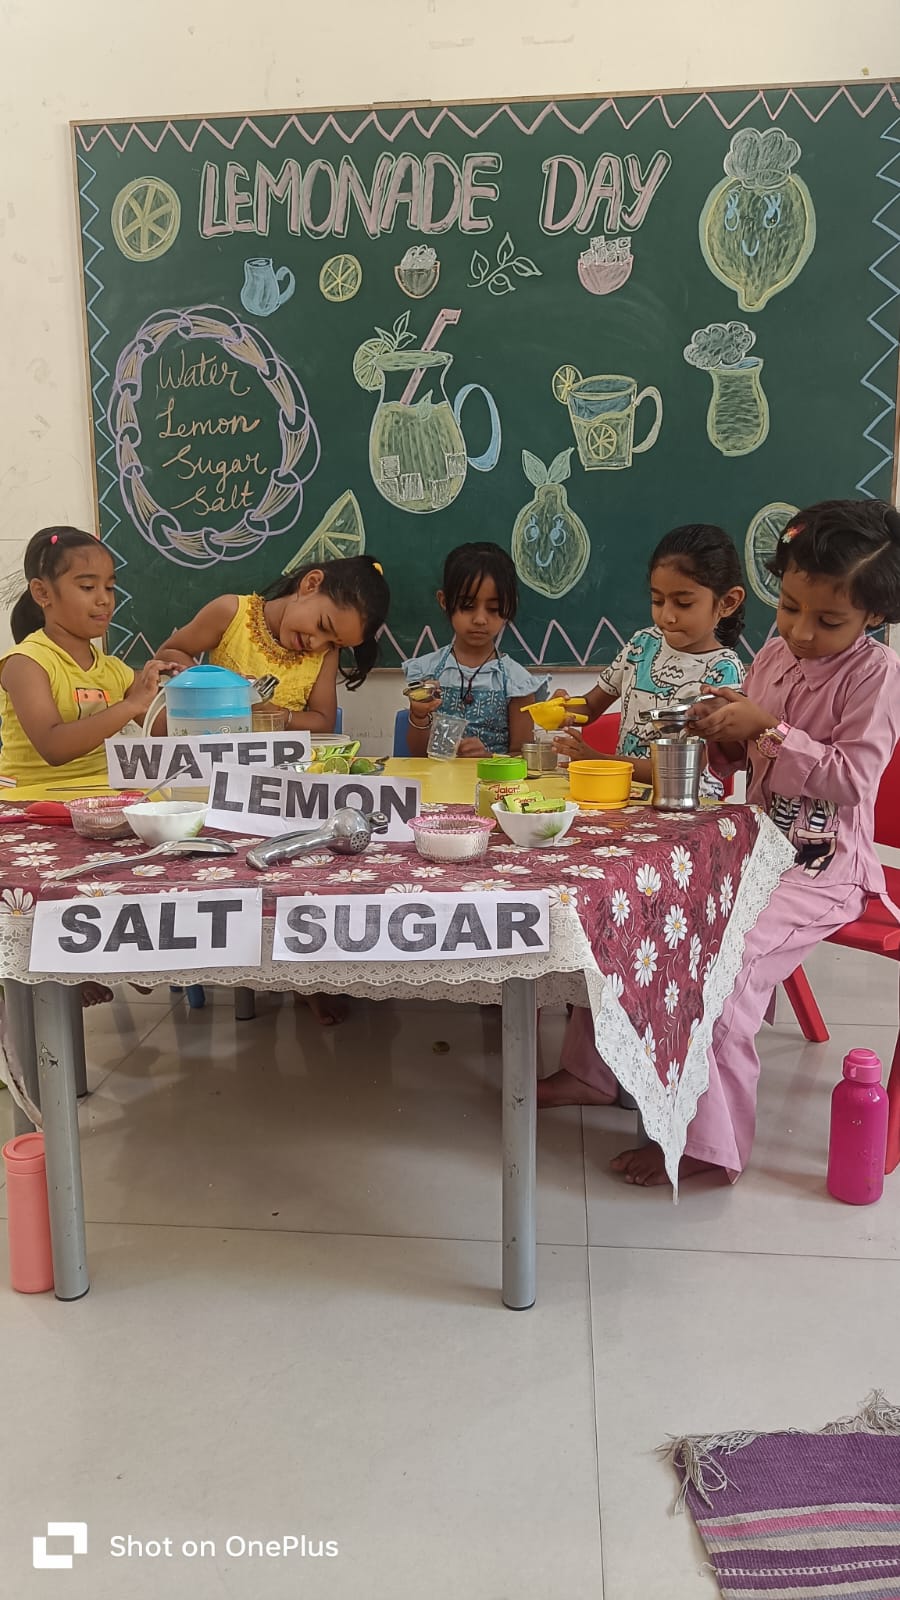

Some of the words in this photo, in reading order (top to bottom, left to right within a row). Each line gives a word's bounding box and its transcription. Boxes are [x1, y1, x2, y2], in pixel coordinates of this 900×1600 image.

[198, 151, 502, 239] LEMONADE
[538, 151, 672, 236] DAY
[156, 349, 251, 397] Water
[156, 398, 261, 439] Lemon
[161, 444, 268, 494] Sugar
[170, 480, 256, 516] Salt
[211, 771, 417, 824] LEMON
[58, 899, 243, 954] SALT
[283, 902, 544, 954] SUGAR
